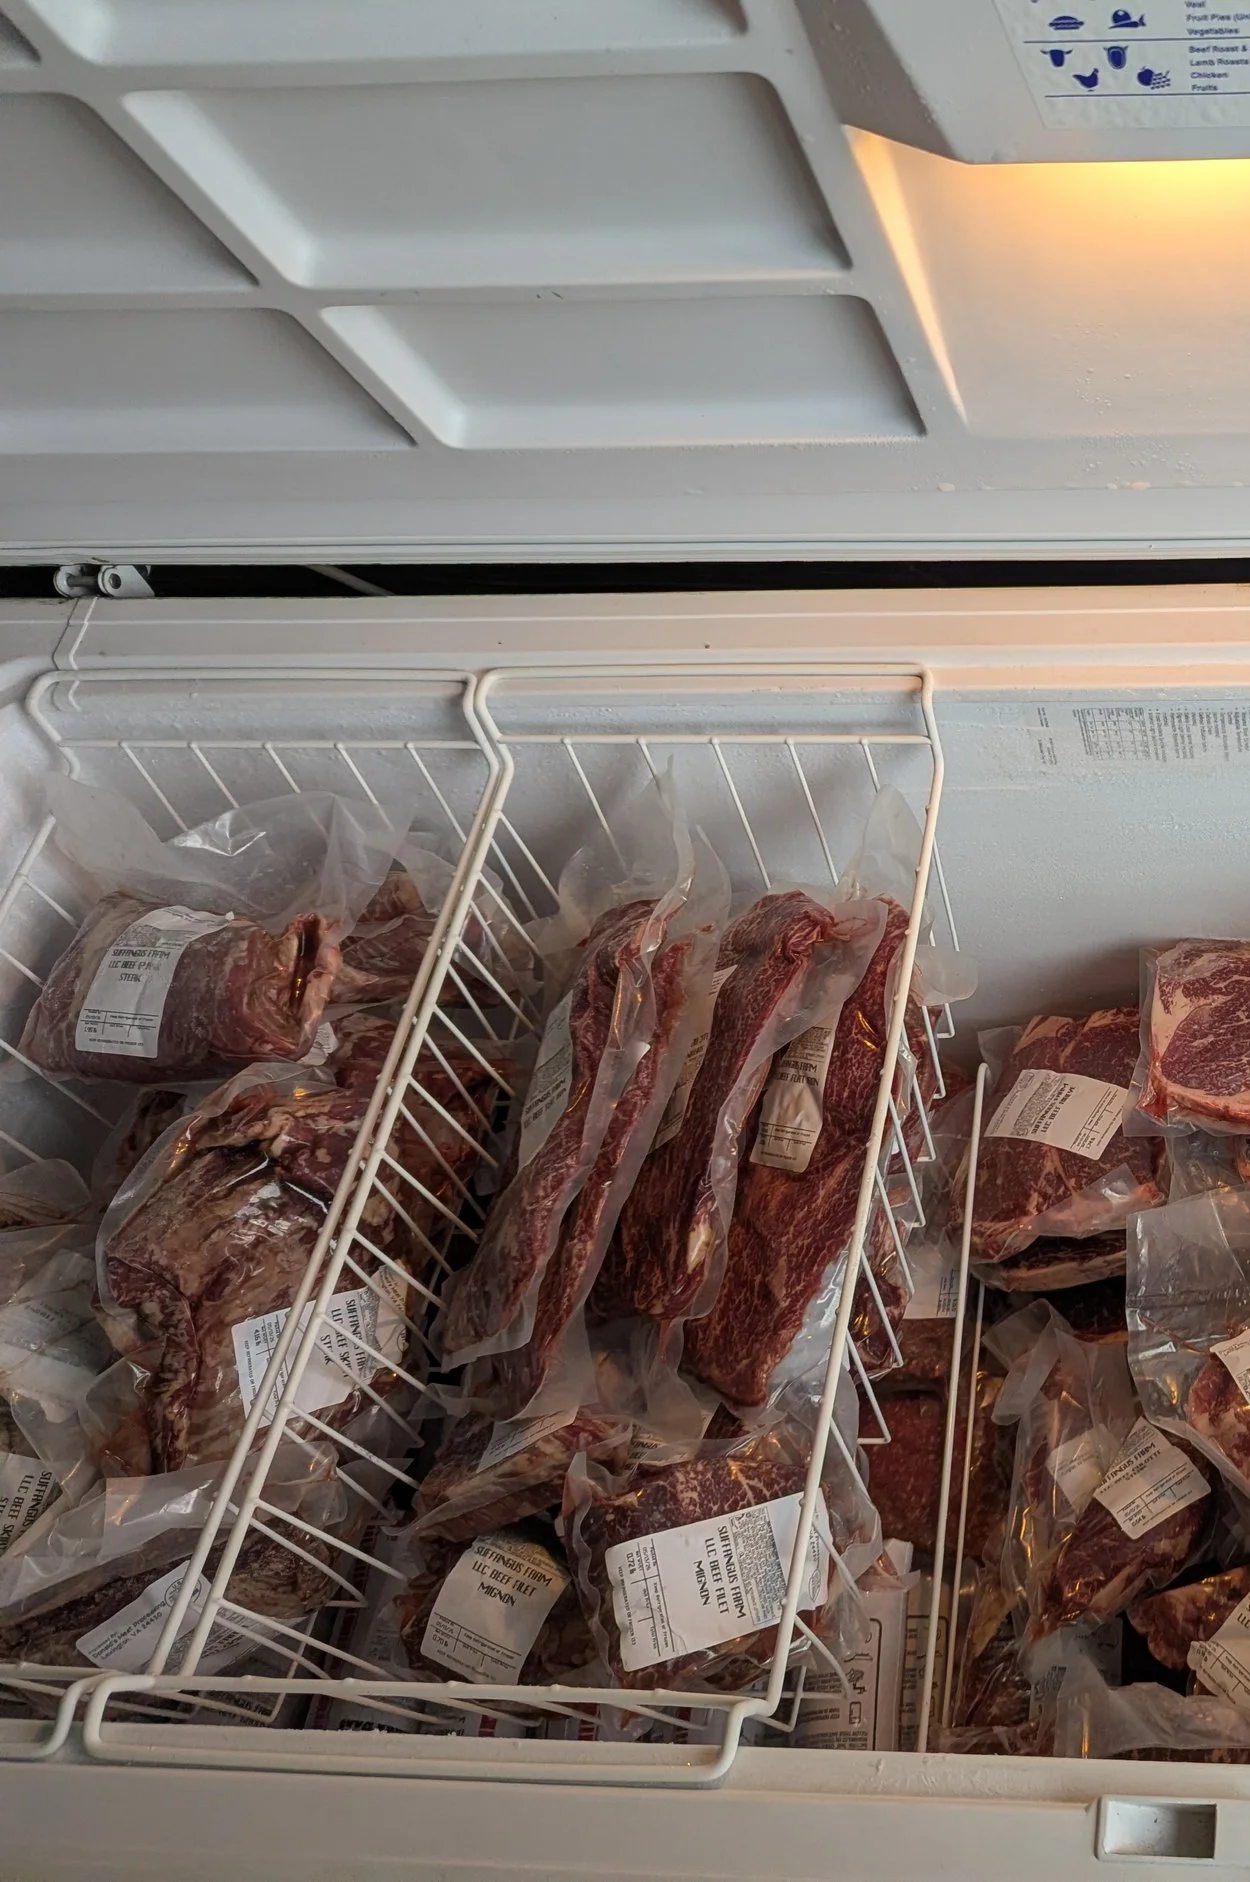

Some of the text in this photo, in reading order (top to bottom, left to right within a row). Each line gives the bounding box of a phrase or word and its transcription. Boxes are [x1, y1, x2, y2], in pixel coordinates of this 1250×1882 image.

[1187, 27, 1239, 36] Vegetables
[1212, 44, 1238, 53] Roast
[1241, 44, 1246, 52] &
[1134, 1442, 1156, 1460] FARM
[18, 1475, 34, 1494] LLC
[8, 1496, 24, 1519] BEEF
[22, 1472, 52, 1527] SUFFANGUS
[471, 1560, 537, 1595] LLC BEEF FILET
[474, 1546, 552, 1586] SUFFANGUS FARM
[705, 1537, 728, 1614] LLC BEEF FILET
[718, 1526, 746, 1618] SUFFANGUS FARM
[478, 1582, 517, 1606] MIGNON
[694, 1560, 710, 1606] MIGNON
